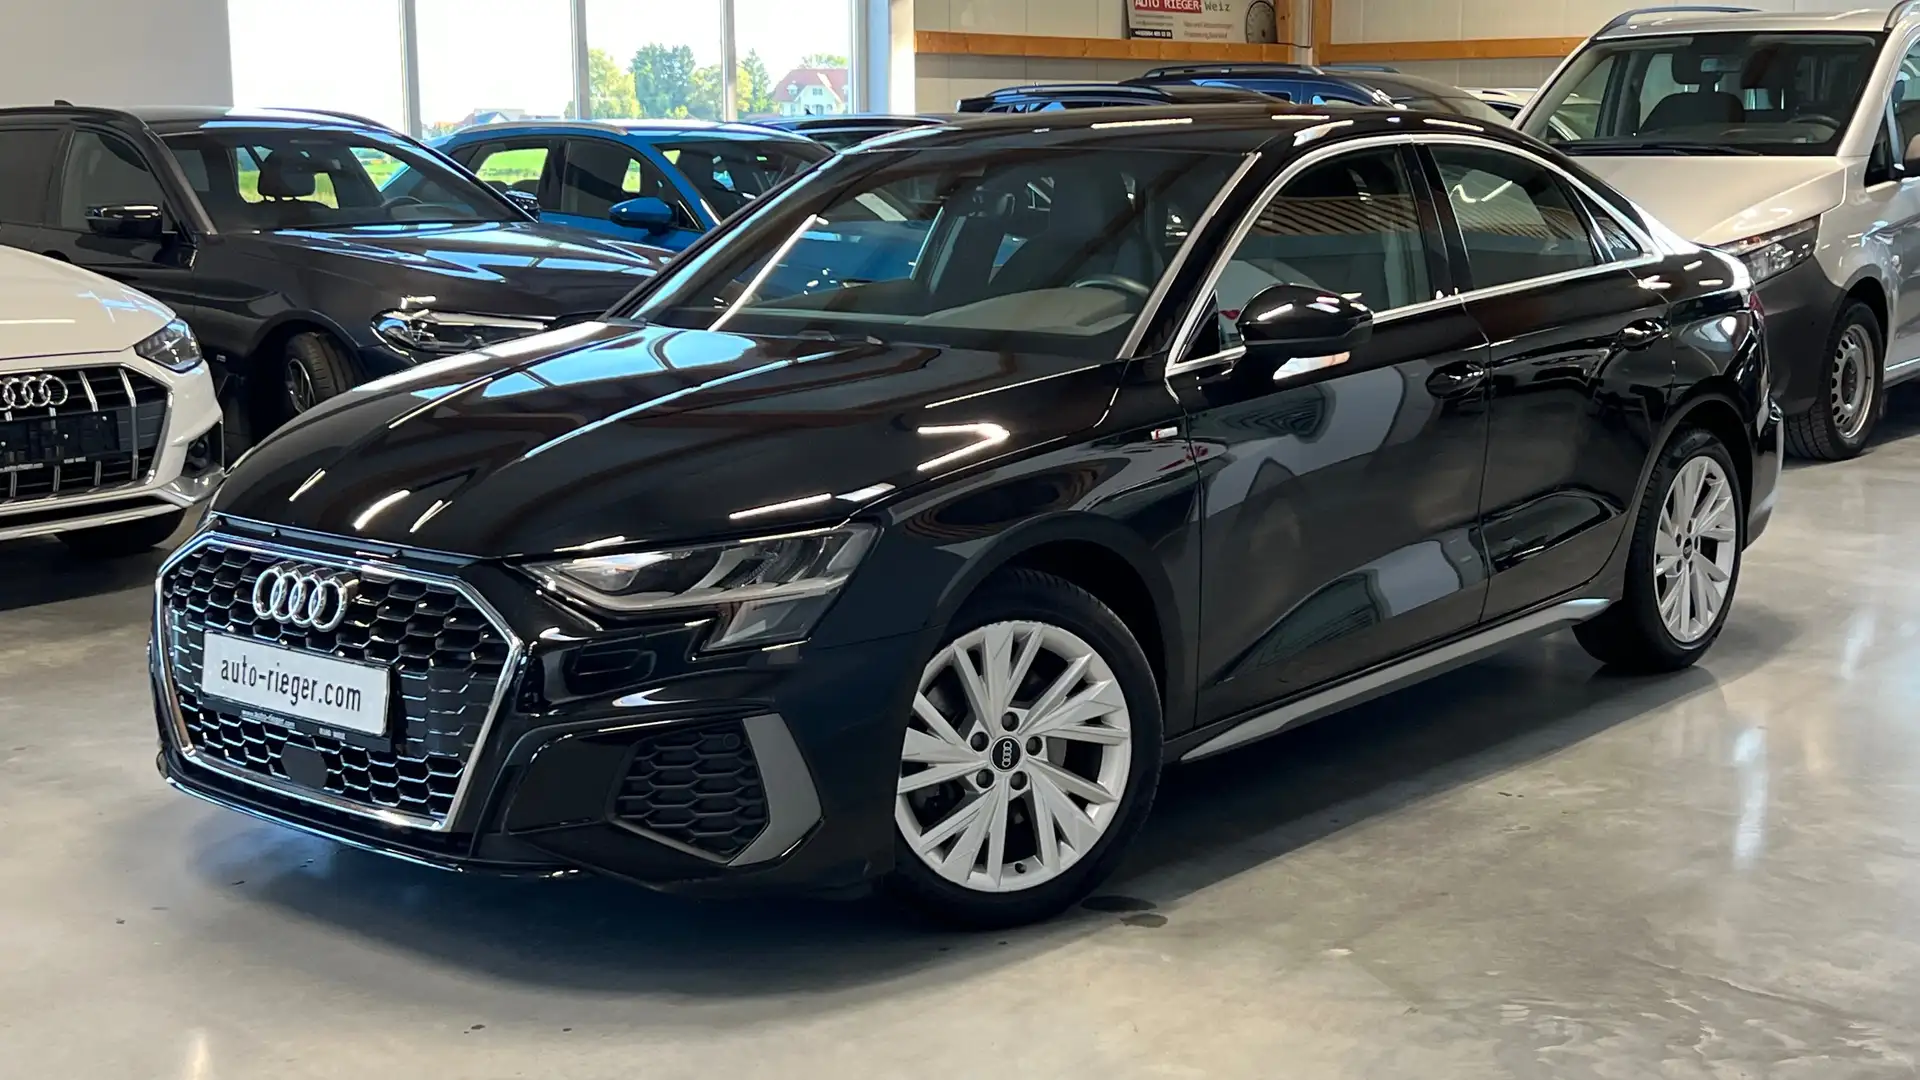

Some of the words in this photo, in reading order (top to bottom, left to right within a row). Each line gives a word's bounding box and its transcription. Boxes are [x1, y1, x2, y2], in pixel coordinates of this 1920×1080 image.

[1134, 0, 1160, 8] AUTO
[1204, 2, 1231, 12] Weiz
[220, 654, 361, 712] auto-rieger.com
